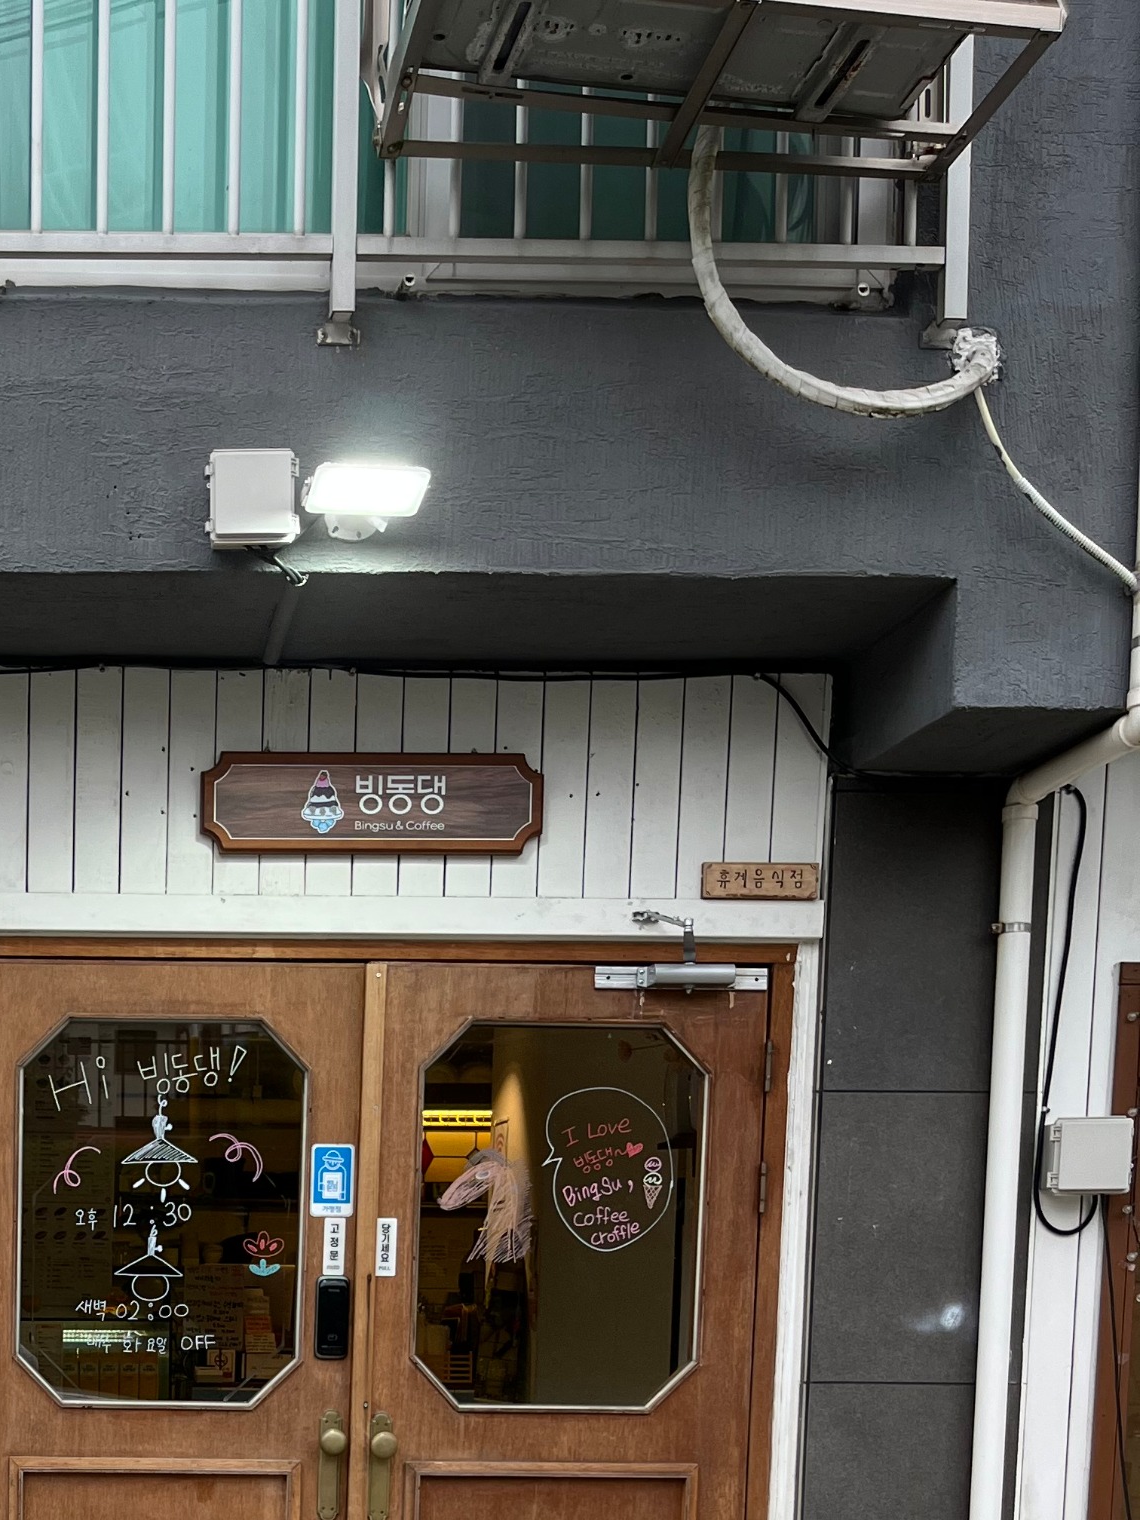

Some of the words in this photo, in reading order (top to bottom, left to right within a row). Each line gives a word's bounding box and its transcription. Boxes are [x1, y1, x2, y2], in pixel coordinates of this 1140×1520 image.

[355, 774, 446, 816] 빙동댕
[354, 820, 394, 832] Bingsu
[395, 820, 404, 831] &
[406, 820, 445, 831] Coffee
[717, 868, 803, 889] 휴게음식점
[48, 1056, 109, 1111] Hi
[137, 1045, 247, 1095] 빙동댕!
[561, 1126, 580, 1148] I
[587, 1118, 632, 1139] Love
[75, 1207, 98, 1231] 오후
[329, 1223, 340, 1261] 고정문
[380, 1223, 391, 1263] 당기세요
[75, 1299, 107, 1321] 새벽
[180, 1334, 216, 1351] OFF
